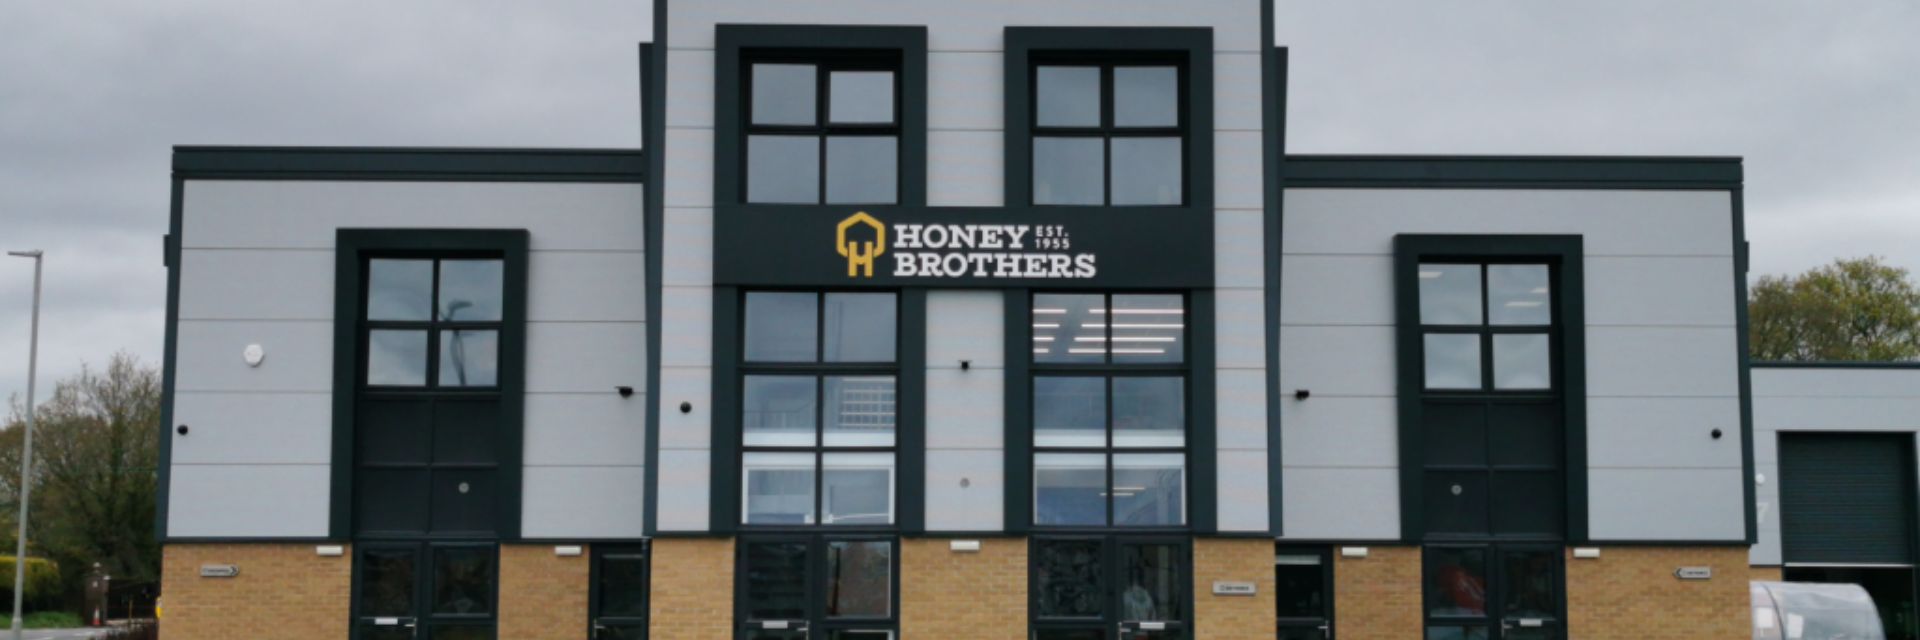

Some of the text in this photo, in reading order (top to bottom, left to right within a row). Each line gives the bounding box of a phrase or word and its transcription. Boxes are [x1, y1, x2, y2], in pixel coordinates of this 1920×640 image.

[893, 224, 1029, 249] HONEY
[1035, 225, 1069, 237] EST.
[1035, 238, 1070, 249] 1955
[893, 252, 1097, 278] BROTHERS
